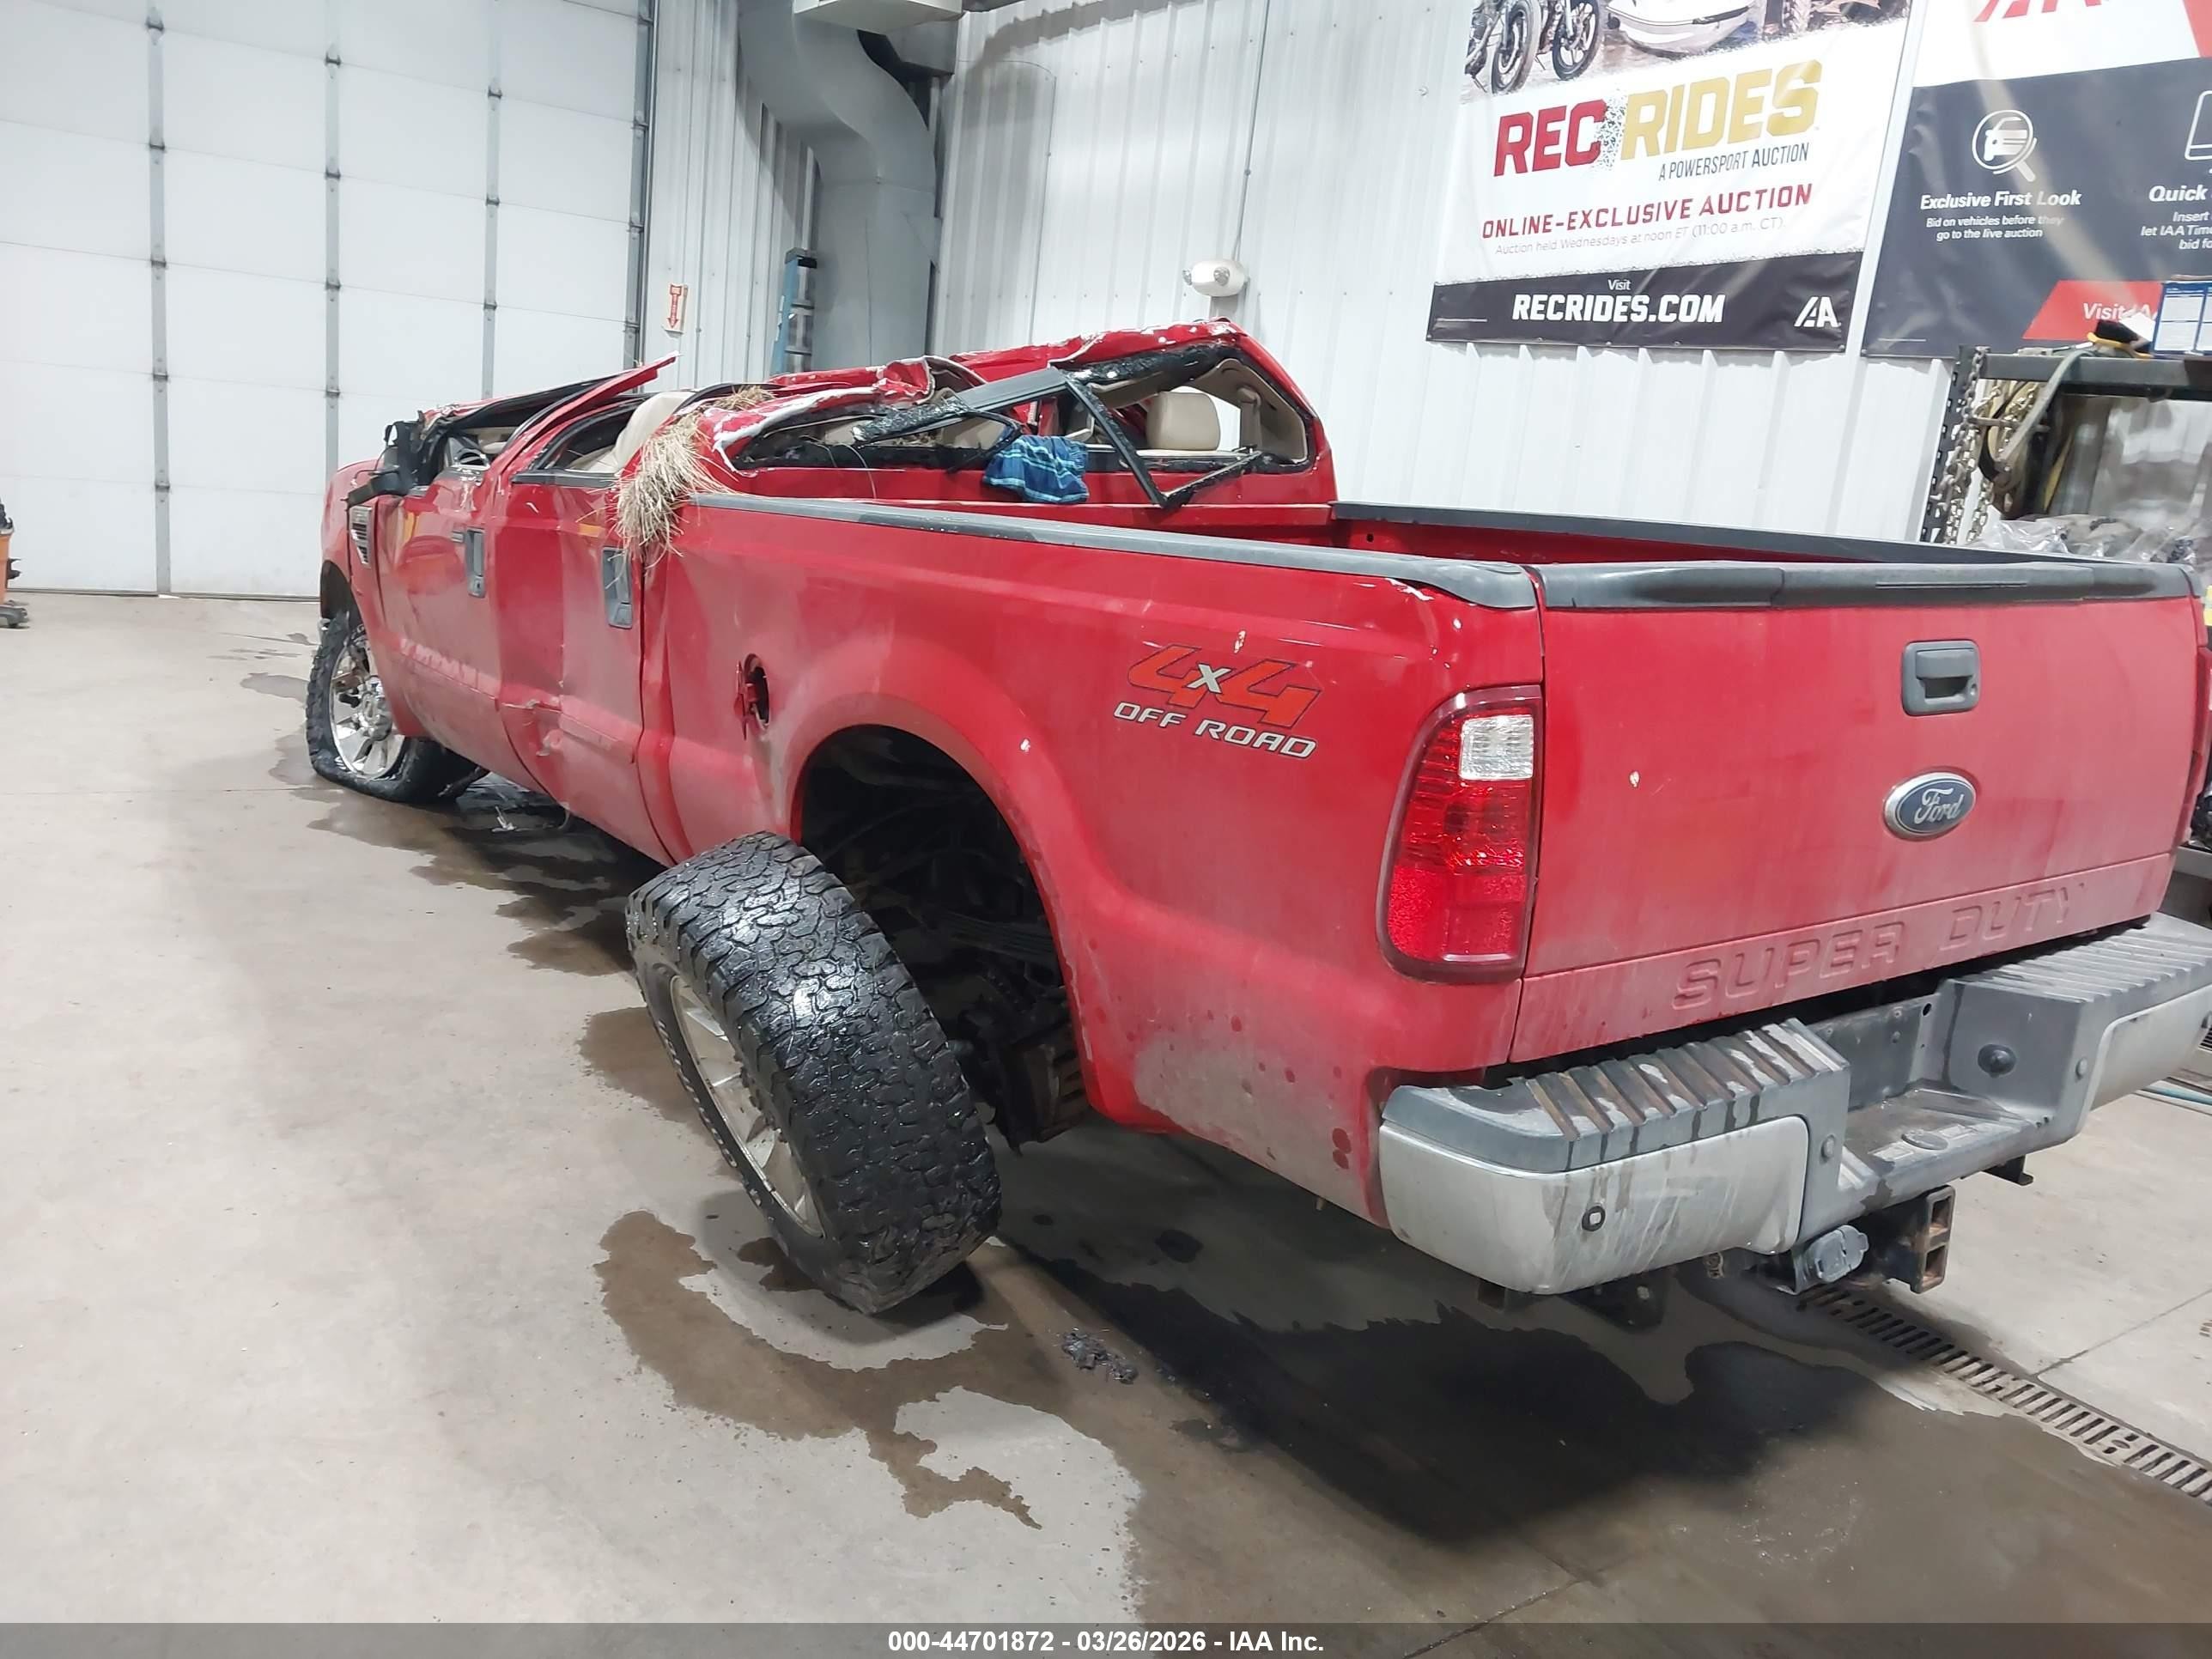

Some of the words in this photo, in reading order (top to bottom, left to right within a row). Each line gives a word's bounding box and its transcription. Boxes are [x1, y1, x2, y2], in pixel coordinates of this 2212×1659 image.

[1493, 98, 1607, 177] REC
[1620, 59, 1822, 161] RIDES
[1658, 163, 1667, 182] A
[1668, 150, 1749, 179] POWERSPORT
[1752, 143, 1809, 168] AUCTION
[1920, 191, 1991, 210] Exclusive
[1994, 190, 2033, 207] First
[2036, 189, 2082, 206] Look
[2148, 184, 2209, 202] Quick
[1482, 198, 1693, 239] ONLINE-EXCLUSIVE
[1699, 183, 1813, 216] AUCTION
[1926, 216, 1942, 228] Bid
[1942, 218, 1955, 227] on
[1958, 215, 2000, 227] vehicles
[2002, 214, 2036, 225] before
[2172, 211, 2210, 222] Insert
[1496, 241, 1533, 255] Auction
[1536, 240, 1558, 252] held
[1560, 234, 1627, 249] Wednesdays
[1631, 233, 1641, 244] at
[1644, 231, 1672, 241] noon
[1675, 226, 1689, 239] ET
[1692, 222, 1728, 240] (11:00
[1936, 230, 1951, 242] go
[1951, 229, 1962, 239] to
[1963, 228, 1980, 239] the
[1982, 228, 2002, 239] live
[2004, 227, 2043, 239] auction
[2141, 225, 2158, 236] let
[2160, 225, 2185, 236] IAA
[2179, 238, 2200, 250] bid
[1607, 278, 1632, 291] Visit
[1511, 293, 1726, 325] RECRIDES.COM
[2082, 302, 2126, 320] Visit
[1114, 702, 1188, 728] OFF
[1194, 719, 1318, 760] ROAD
[1914, 787, 1966, 824] Ford
[1671, 920, 1905, 1012] SUPER
[1938, 882, 2087, 951] DUTY
